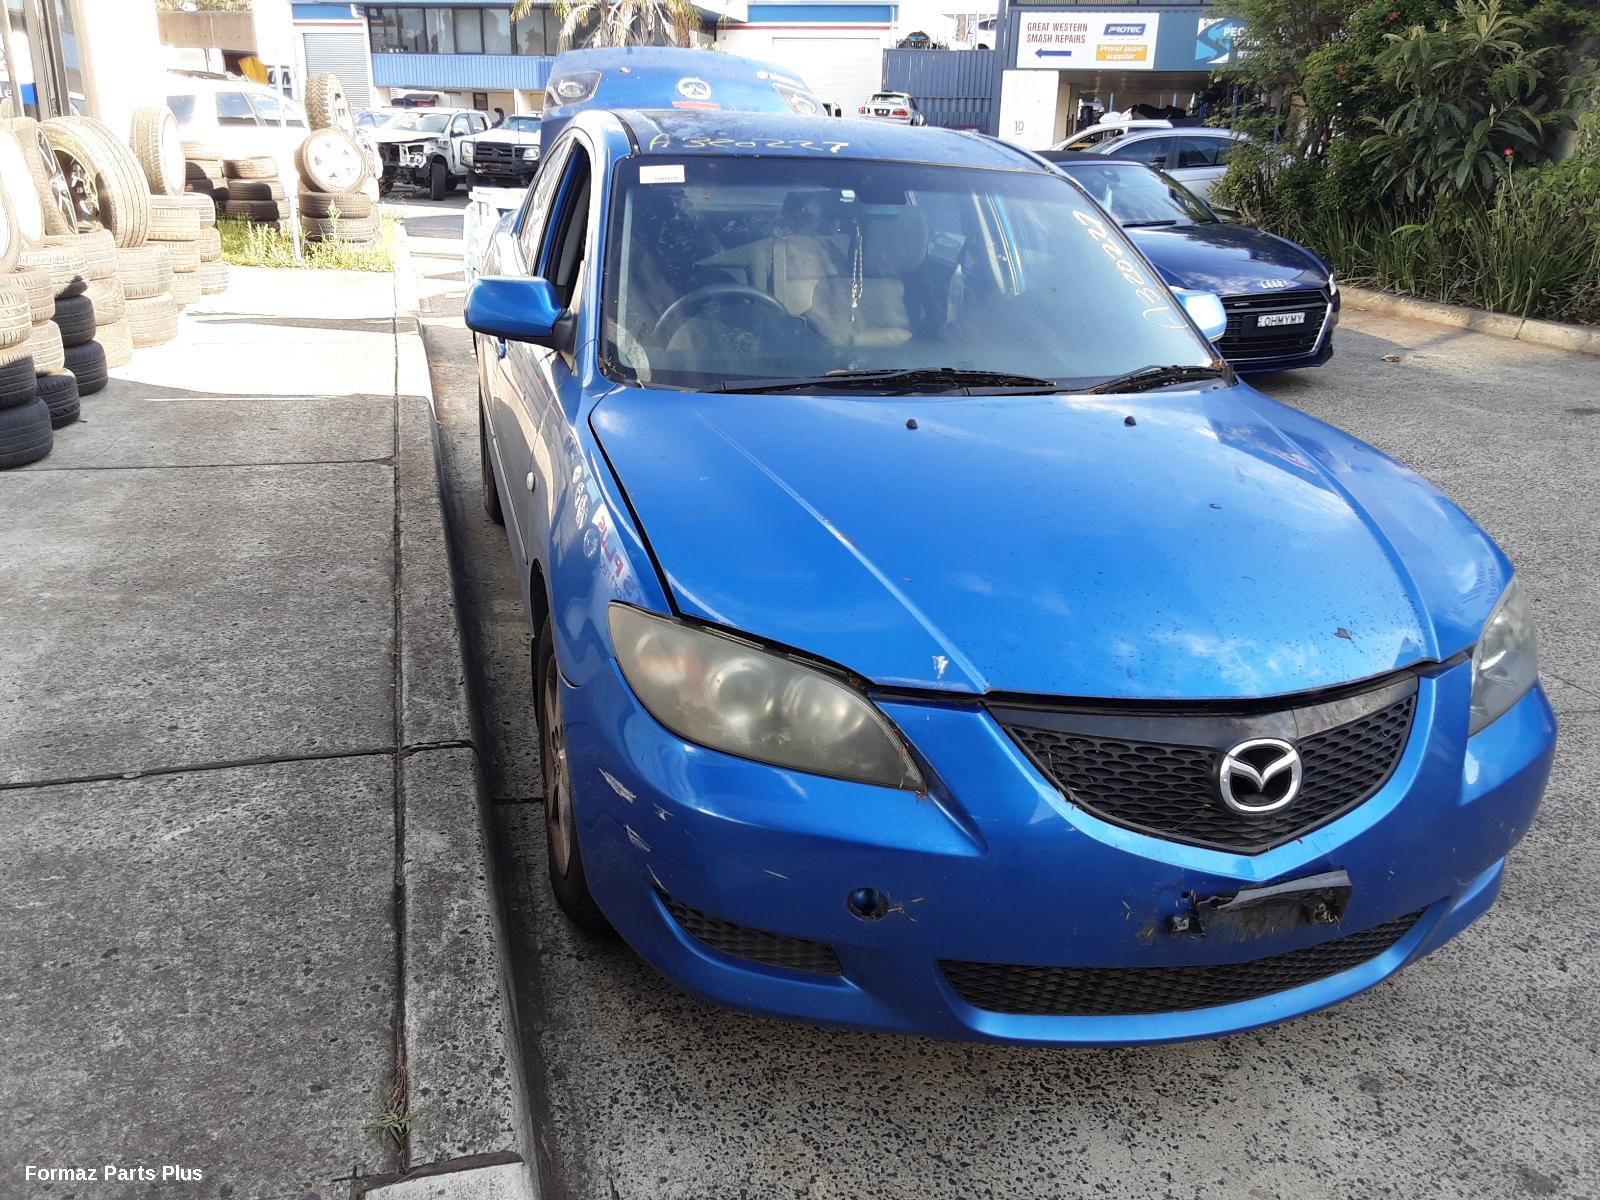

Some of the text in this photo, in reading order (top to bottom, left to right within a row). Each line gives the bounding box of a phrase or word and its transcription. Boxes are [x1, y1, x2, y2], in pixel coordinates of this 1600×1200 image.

[1027, 22, 1088, 32] GREAT WESTERN
[1026, 34, 1086, 44] SMASH REPAIRS
[1014, 120, 1024, 132] 10
